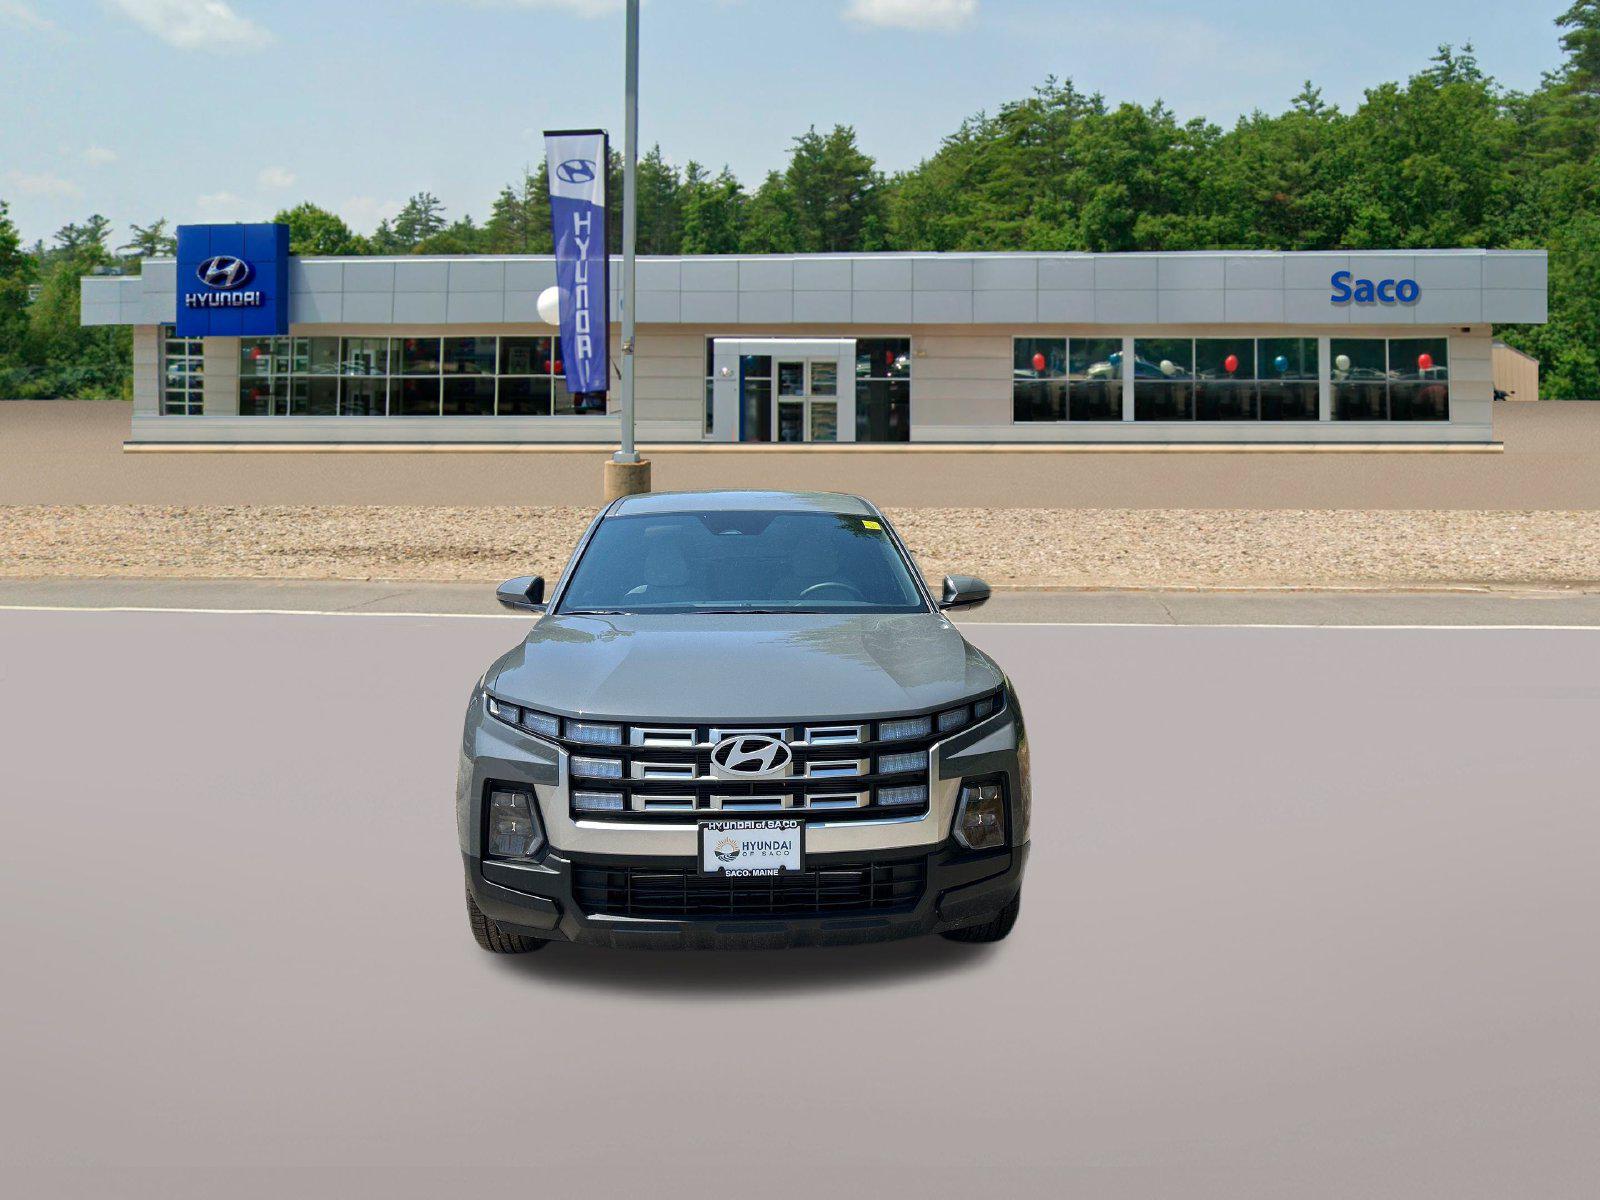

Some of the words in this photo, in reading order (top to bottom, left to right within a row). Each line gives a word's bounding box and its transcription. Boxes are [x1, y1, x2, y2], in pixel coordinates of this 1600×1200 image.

[1330, 270, 1420, 303] Saco
[185, 291, 260, 307] HYUNDAI
[573, 210, 592, 384] HYUNDAI
[708, 821, 755, 830] HYUNDAI
[755, 820, 766, 829] of
[767, 820, 797, 829] SACO
[742, 840, 792, 851] HYUNDAI
[752, 868, 779, 877] MAINE
